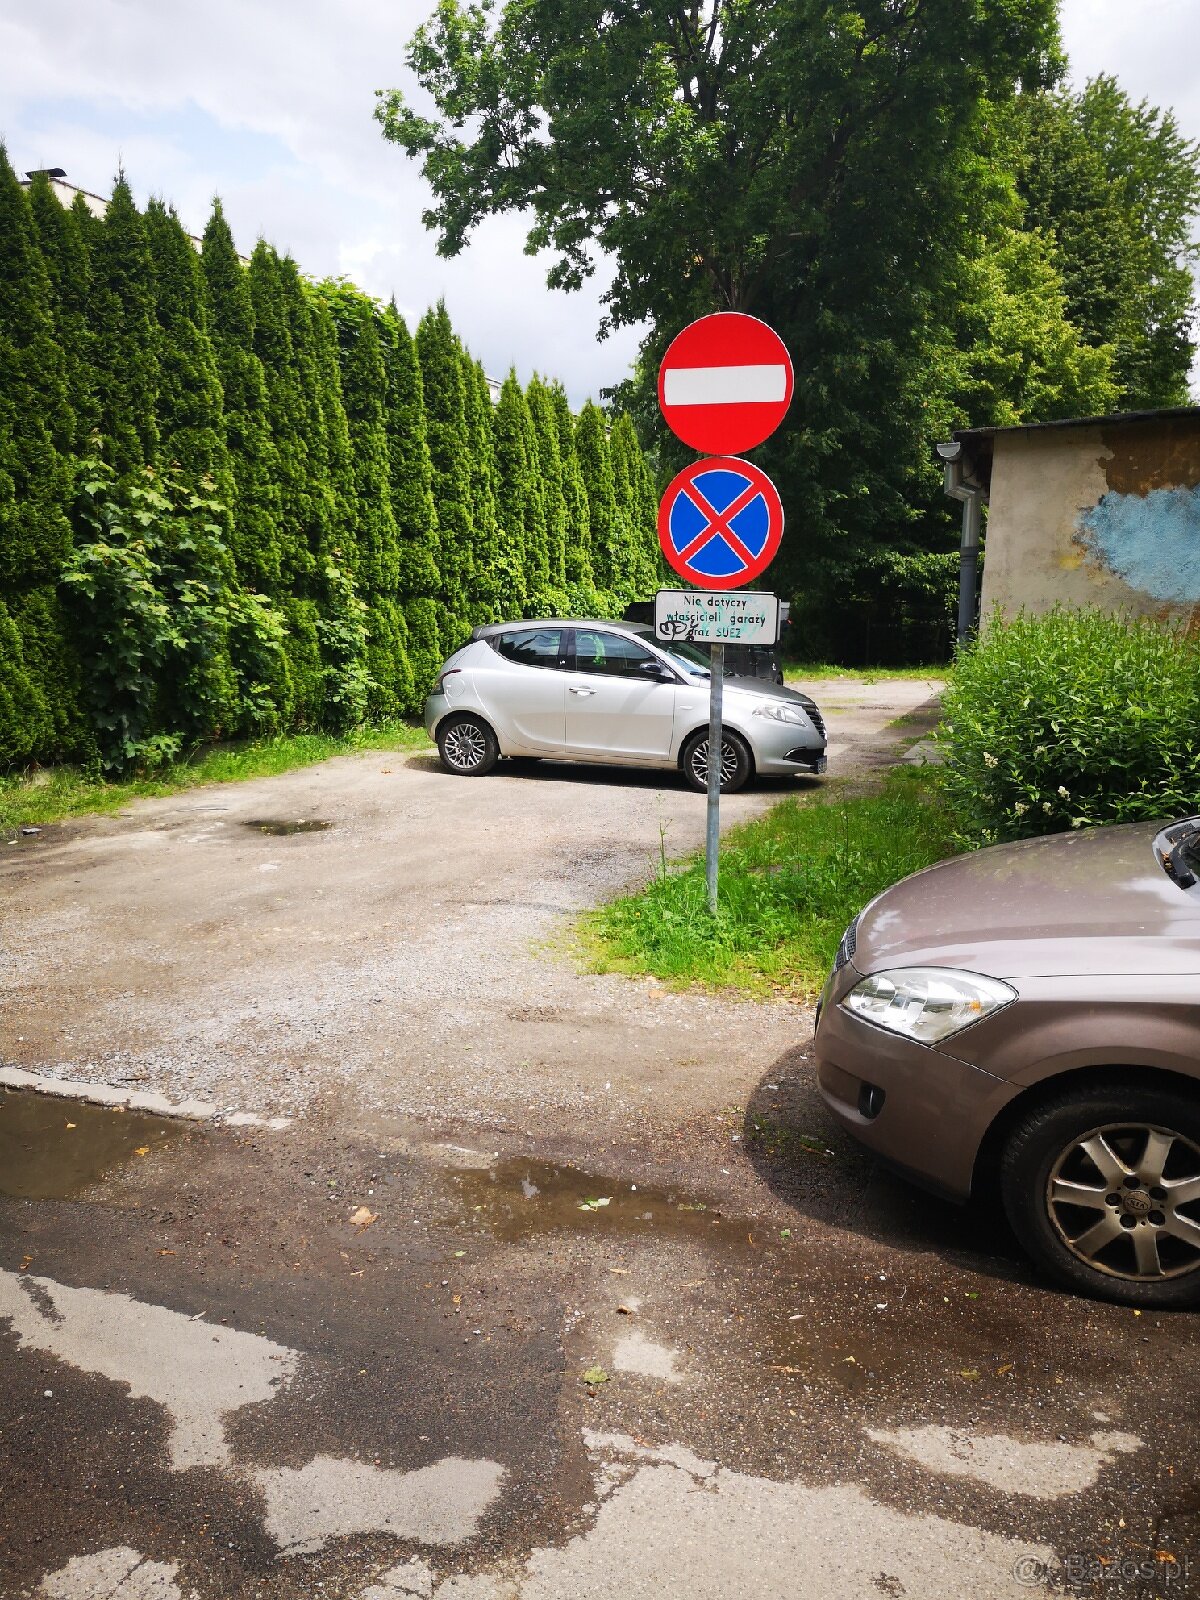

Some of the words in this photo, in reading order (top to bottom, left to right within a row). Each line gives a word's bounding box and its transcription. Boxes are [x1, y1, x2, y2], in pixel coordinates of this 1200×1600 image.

[684, 596, 701, 606] Nie
[707, 597, 746, 610] dotyczy
[667, 611, 721, 621] właścicieli
[730, 612, 765, 627] garaży
